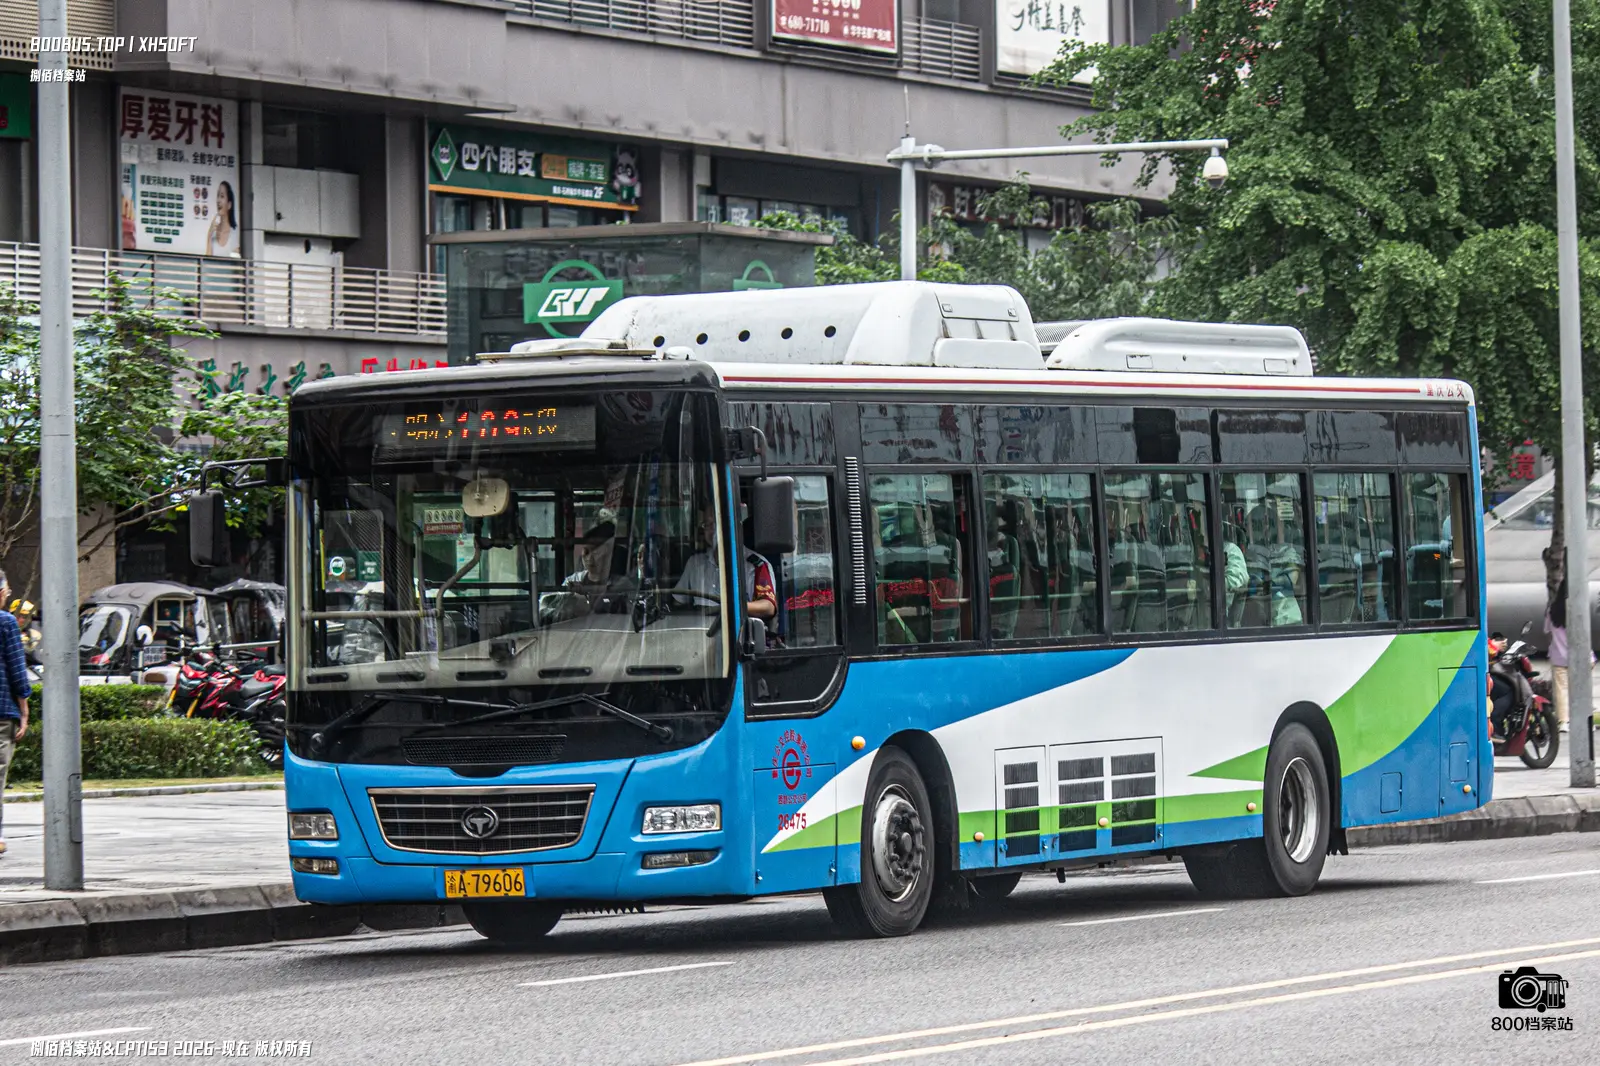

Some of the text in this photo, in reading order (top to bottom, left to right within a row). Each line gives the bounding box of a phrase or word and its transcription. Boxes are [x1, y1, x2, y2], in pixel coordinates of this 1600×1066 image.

[120, 94, 225, 149] 厚爱牙科
[461, 142, 536, 178] 四个朋友
[777, 813, 807, 831] 26475
